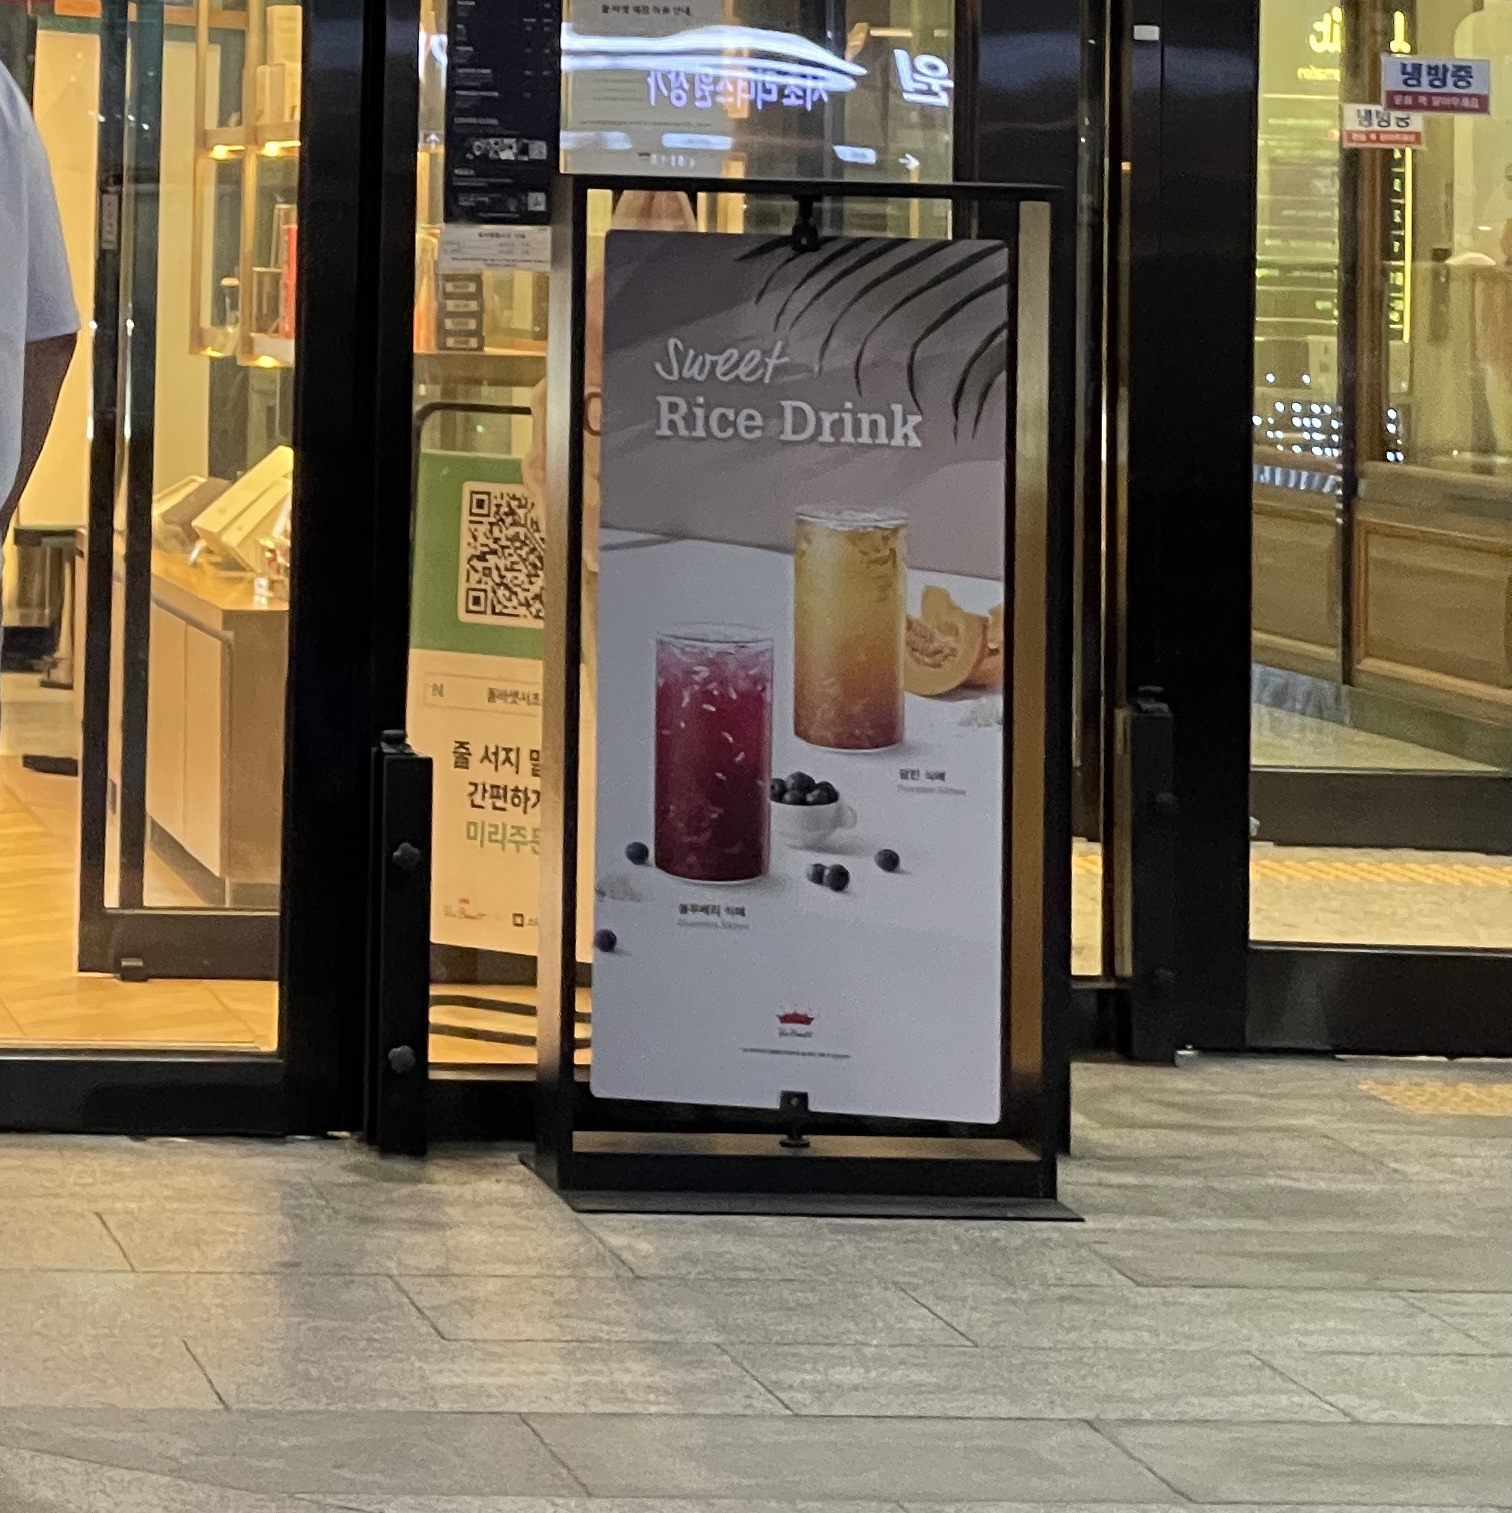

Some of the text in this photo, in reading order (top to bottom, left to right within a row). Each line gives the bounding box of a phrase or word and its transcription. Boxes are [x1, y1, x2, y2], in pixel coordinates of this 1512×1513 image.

[1399, 61, 1474, 90] 냉방중
[654, 335, 790, 384] Sweet
[654, 395, 925, 449] Rice Drink
[452, 739, 473, 771] 줄
[479, 743, 521, 776] 서지
